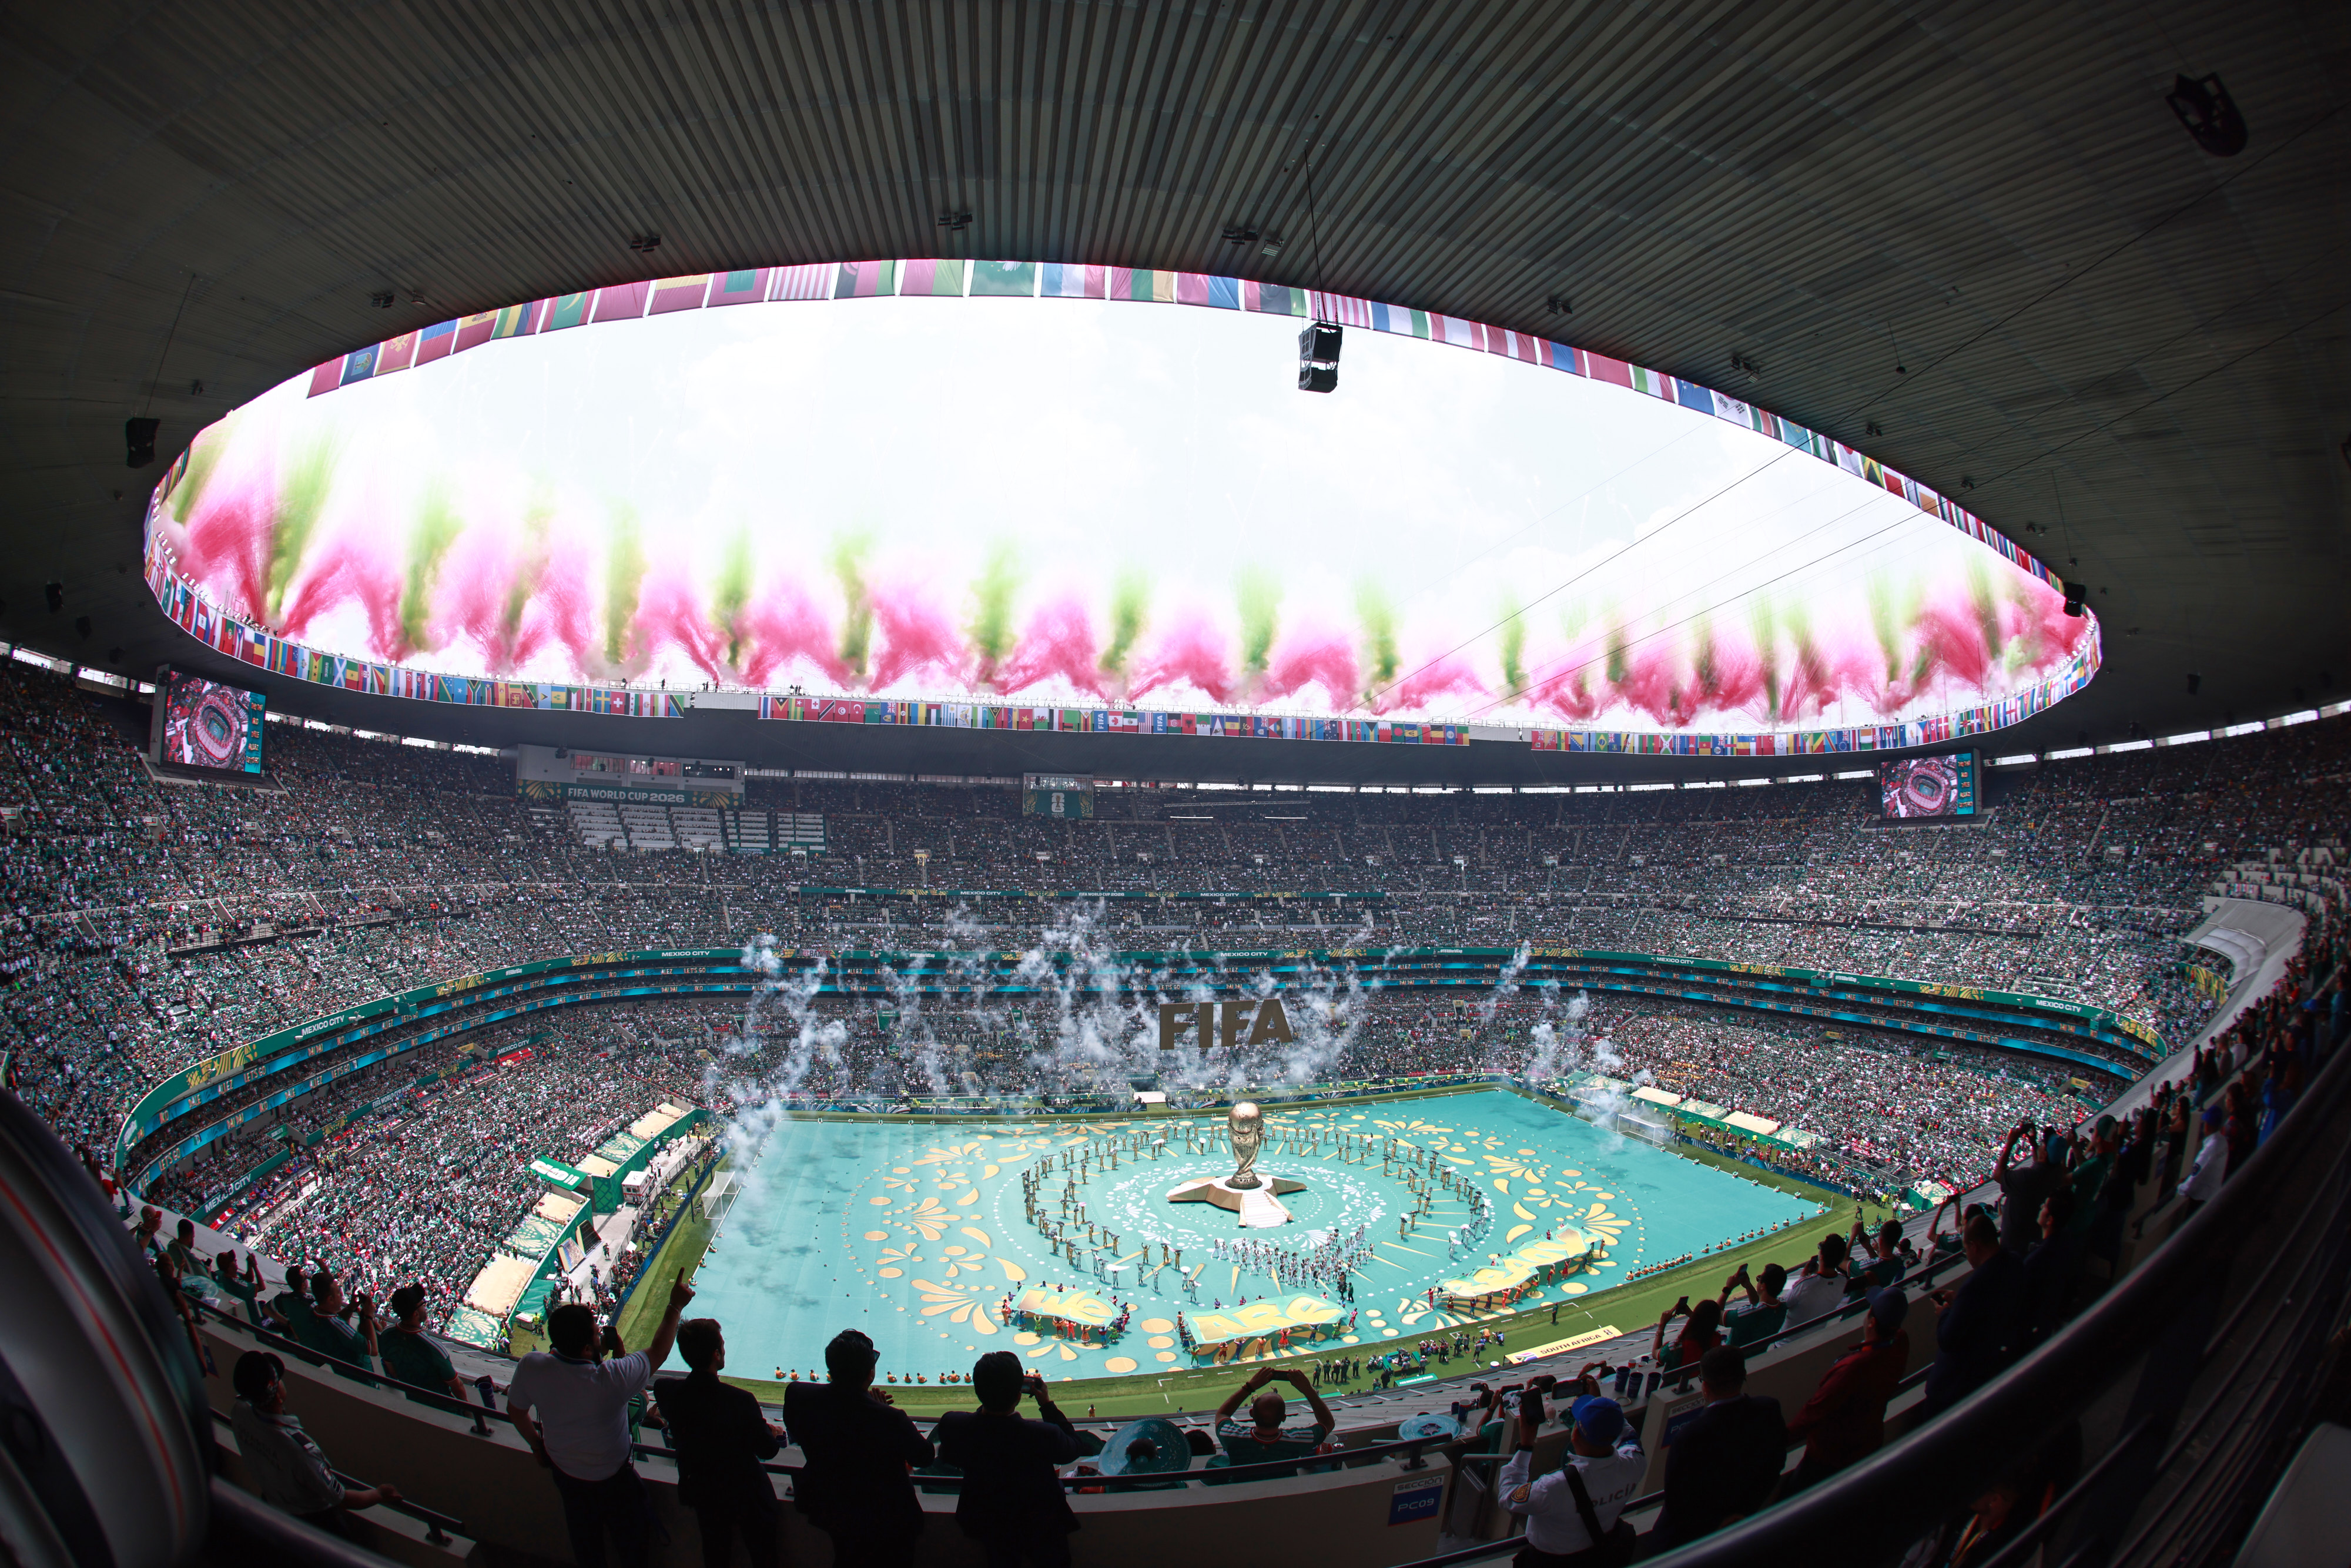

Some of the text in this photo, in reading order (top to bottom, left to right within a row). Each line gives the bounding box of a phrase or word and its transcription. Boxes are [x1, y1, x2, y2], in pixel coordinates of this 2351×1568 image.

[568, 788, 685, 803] FIFA WORLD CUP 2026
[2035, 999, 2082, 1013] MEXICO CITY
[302, 1015, 344, 1036] MEXICO CITY
[1160, 999, 1293, 1050] FIFA
[498, 1043, 517, 1054] MEXICO
[243, 1070, 258, 1083] LET'S
[258, 1066, 266, 1077] GO
[331, 1066, 344, 1078] LET'S
[344, 1064, 350, 1073] GO
[373, 1100, 381, 1108] FIFA
[381, 1093, 394, 1104] WORLD
[159, 1148, 181, 1172] LET'S GO
[235, 1174, 252, 1191] CITY
[1540, 1334, 1602, 1354] SOUTH AFRICA
[1398, 1498, 1435, 1512] PC09
